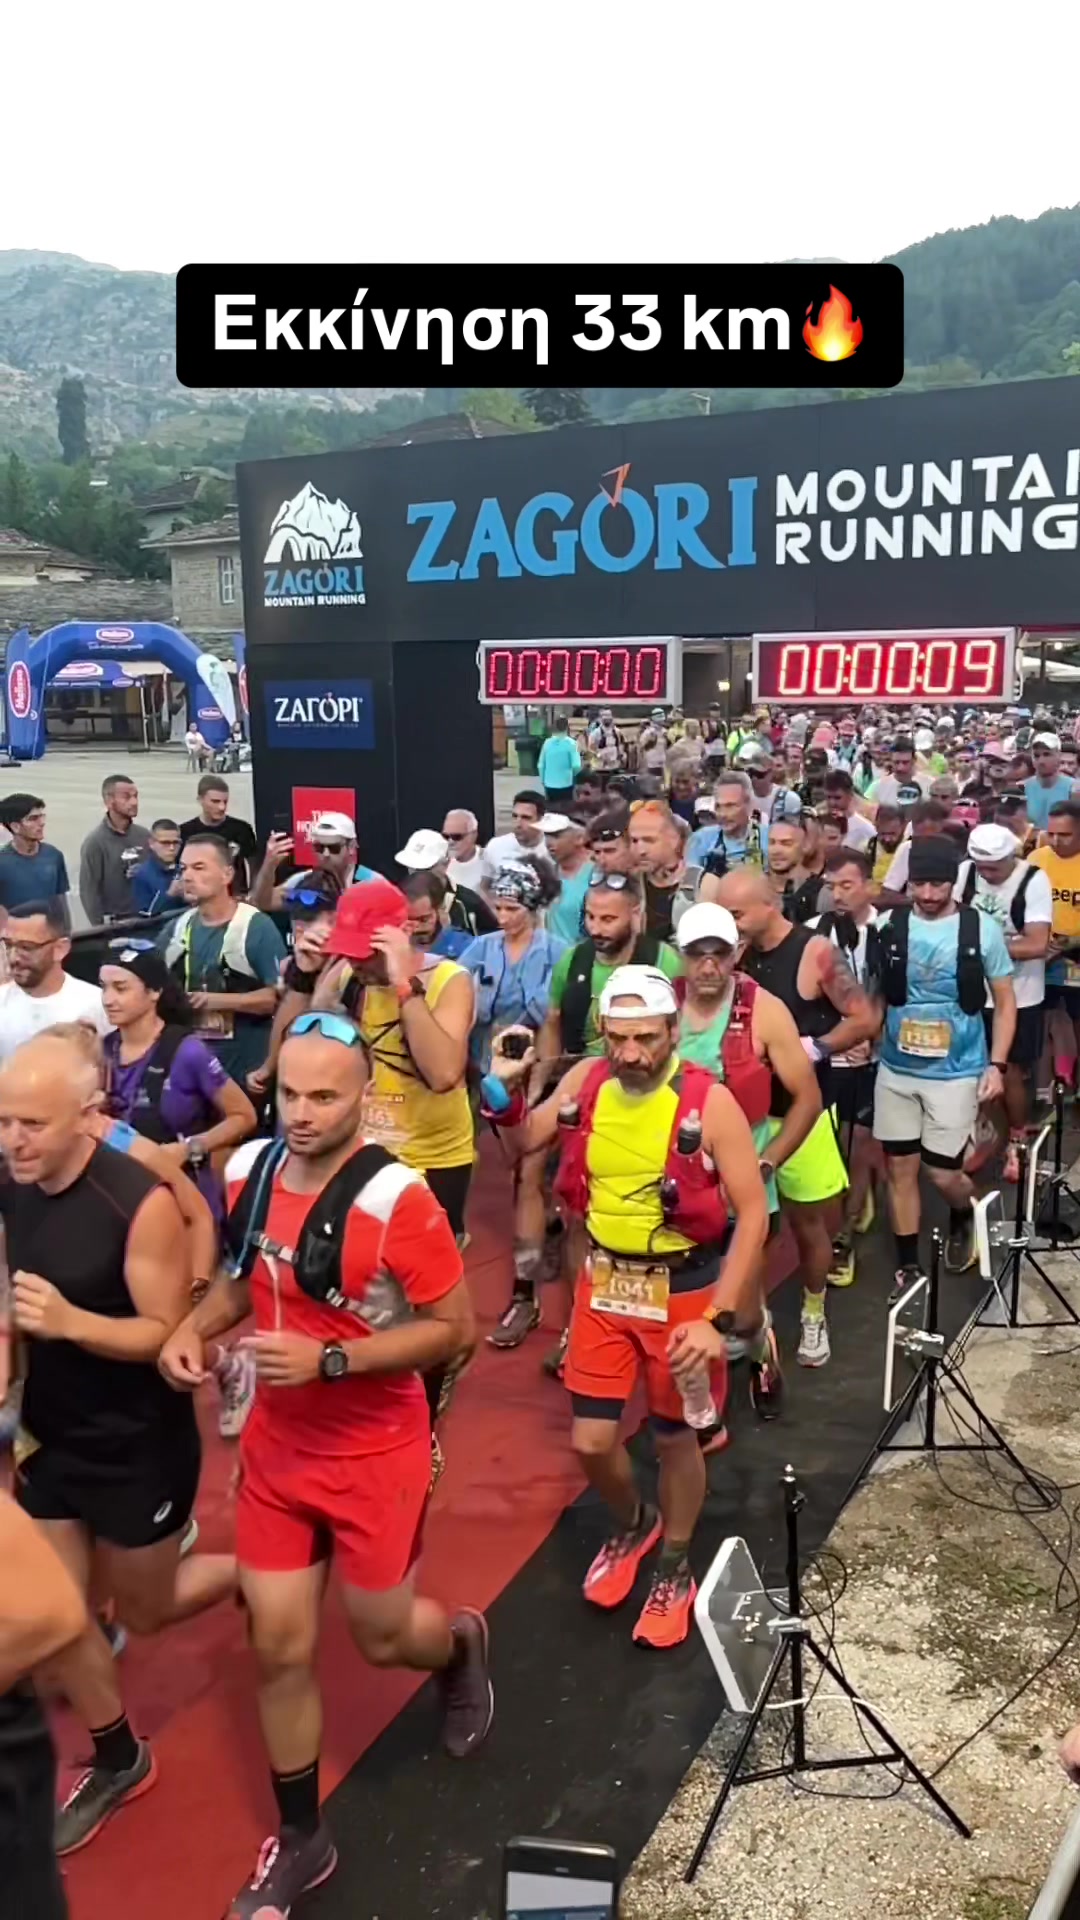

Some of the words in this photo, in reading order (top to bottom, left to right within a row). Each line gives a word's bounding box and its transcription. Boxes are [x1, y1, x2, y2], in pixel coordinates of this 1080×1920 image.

[775, 502, 1080, 565] RUNNING
[264, 595, 315, 607] MOUNTAIN
[317, 593, 367, 606] RUNNING
[488, 647, 662, 695] 00:00:00
[778, 639, 998, 695] 00:00:09
